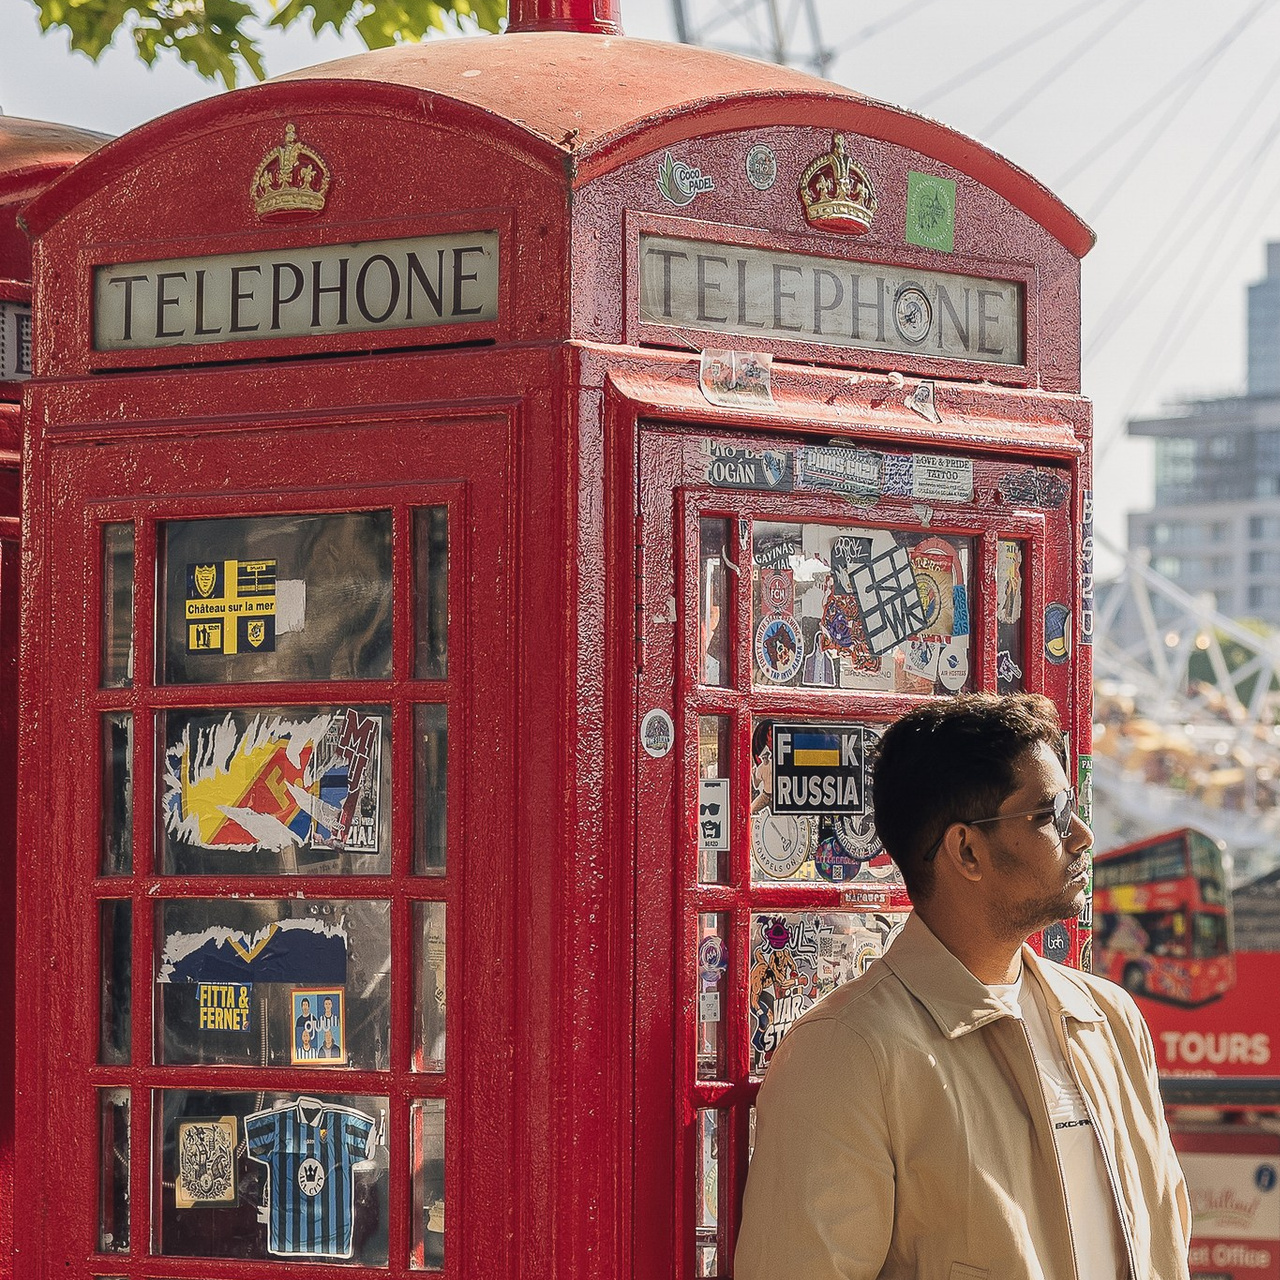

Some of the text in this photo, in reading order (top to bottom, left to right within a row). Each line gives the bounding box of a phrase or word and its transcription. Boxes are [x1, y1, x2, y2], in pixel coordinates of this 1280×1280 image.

[680, 169, 700, 180] COCO
[688, 177, 714, 192] PADEL
[107, 245, 485, 342] TELEPHONE
[644, 247, 1006, 356] TELEPHONE
[916, 456, 970, 469] LOVE & PRIDE
[928, 470, 958, 480] TATTOO
[770, 588, 785, 600] FCN
[187, 601, 275, 614] Château sur la mer
[770, 645, 802, 680] TAP INTO ALASKA
[777, 775, 859, 807] RUSSIA
[755, 841, 783, 872] POMPELS
[786, 858, 797, 870] ON
[200, 985, 249, 1008] FITTA &
[200, 1008, 249, 1030] FERNET
[1160, 1031, 1271, 1065] TOURS
[308, 1175, 323, 1195] CITY
[1212, 1245, 1271, 1268] Office
